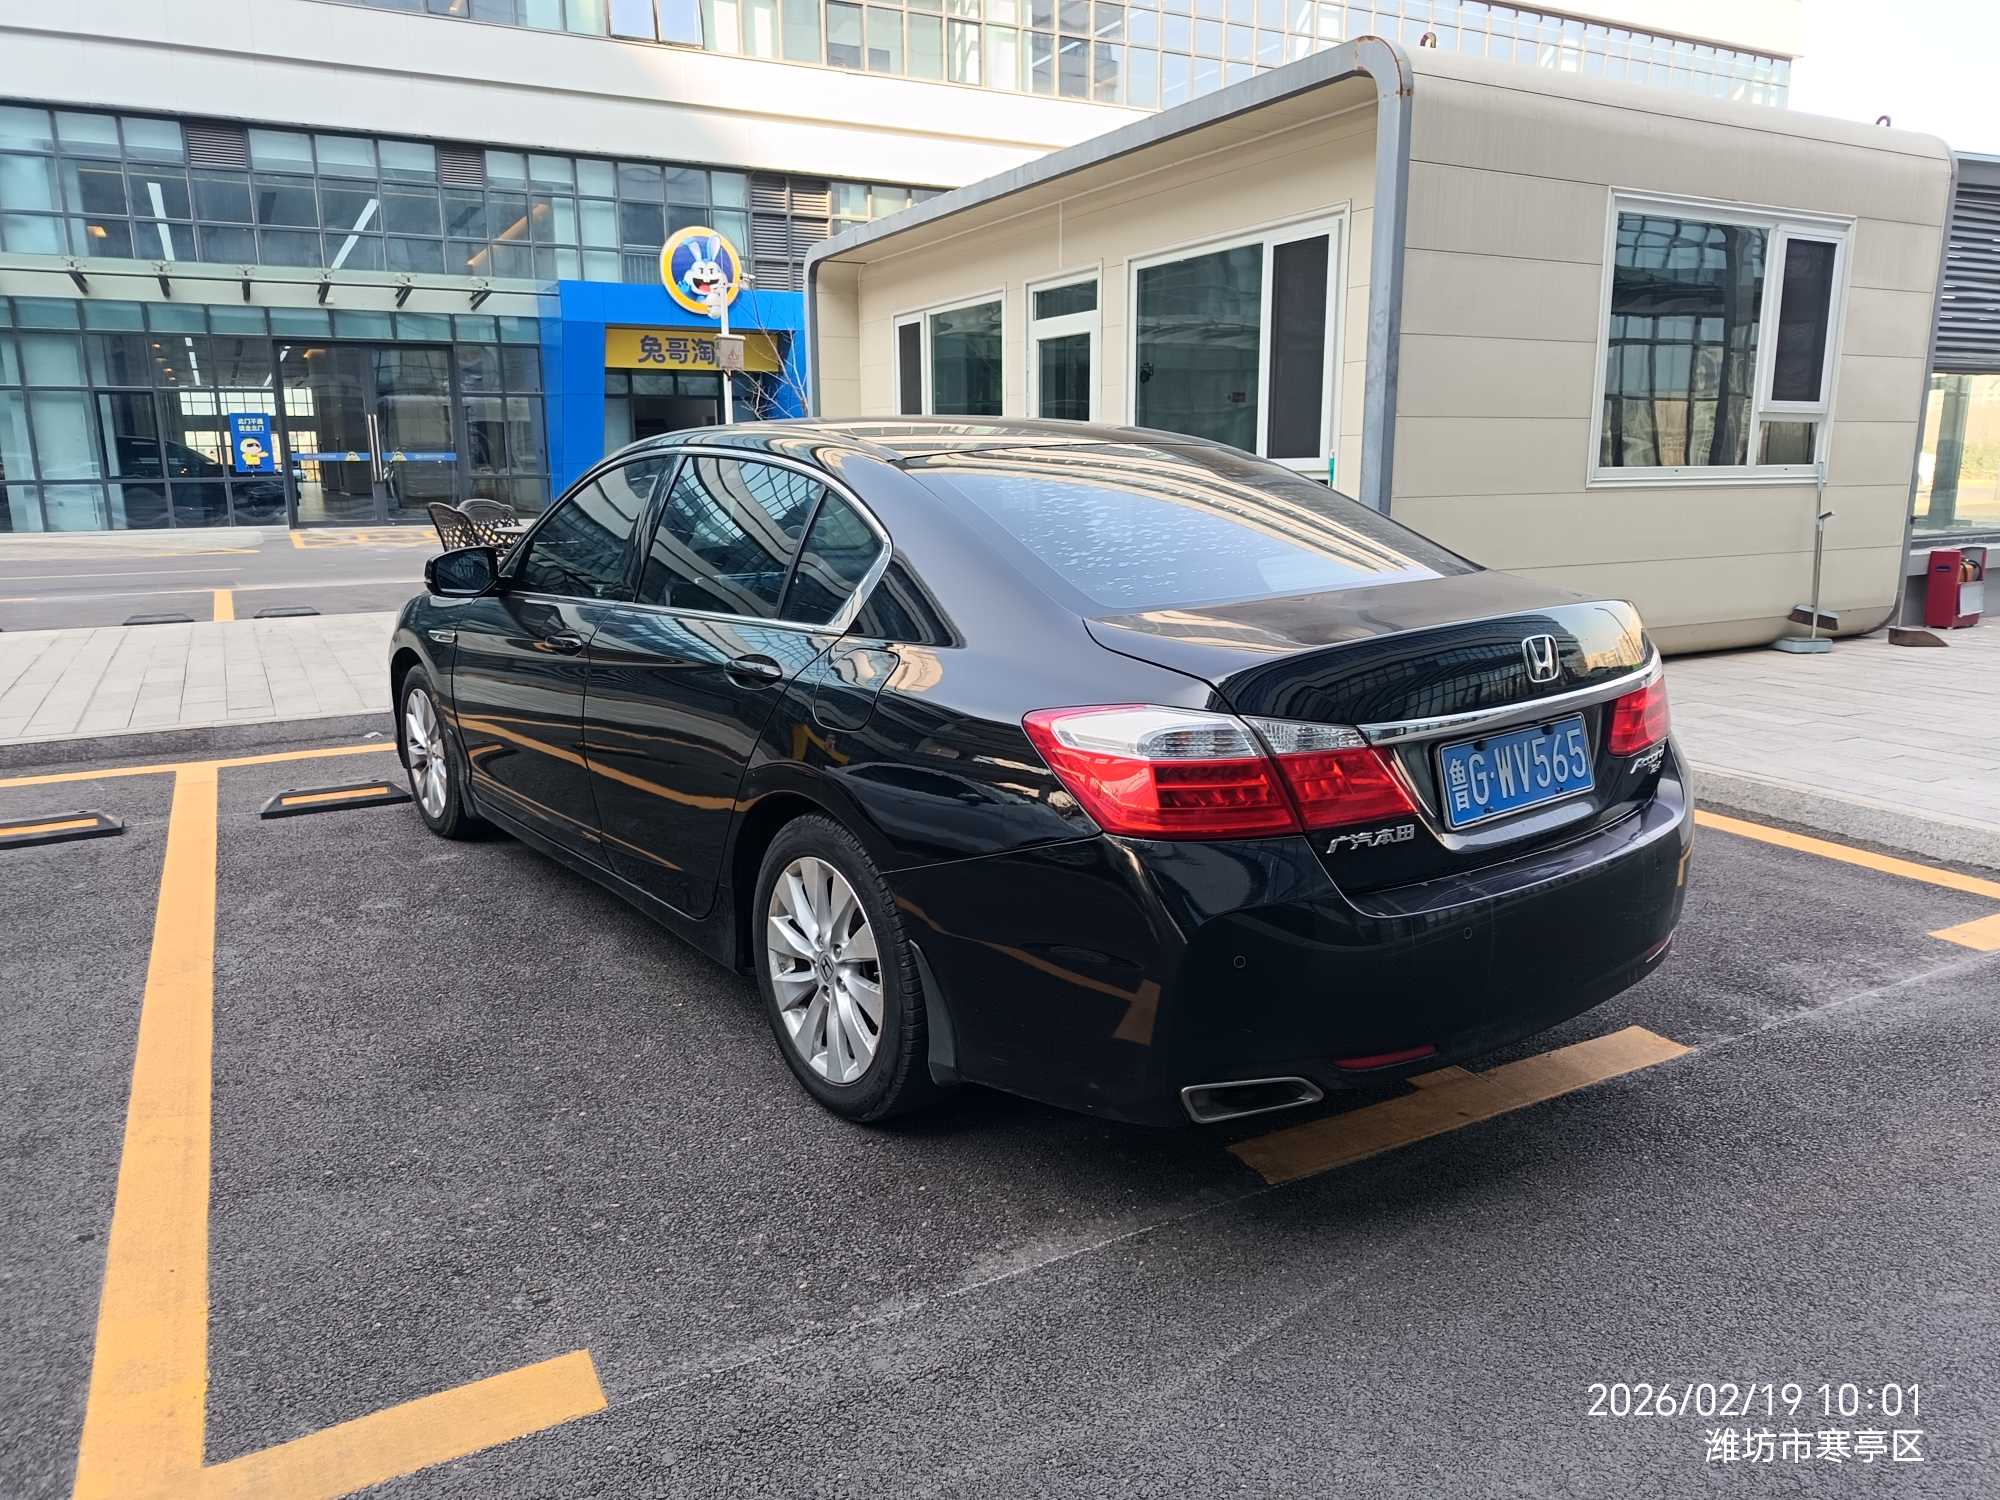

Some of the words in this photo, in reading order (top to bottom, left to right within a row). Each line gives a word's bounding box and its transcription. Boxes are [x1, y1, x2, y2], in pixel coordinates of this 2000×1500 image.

[638, 334, 720, 367] 兔哥淘
[1325, 823, 1415, 854] 广汽本田
